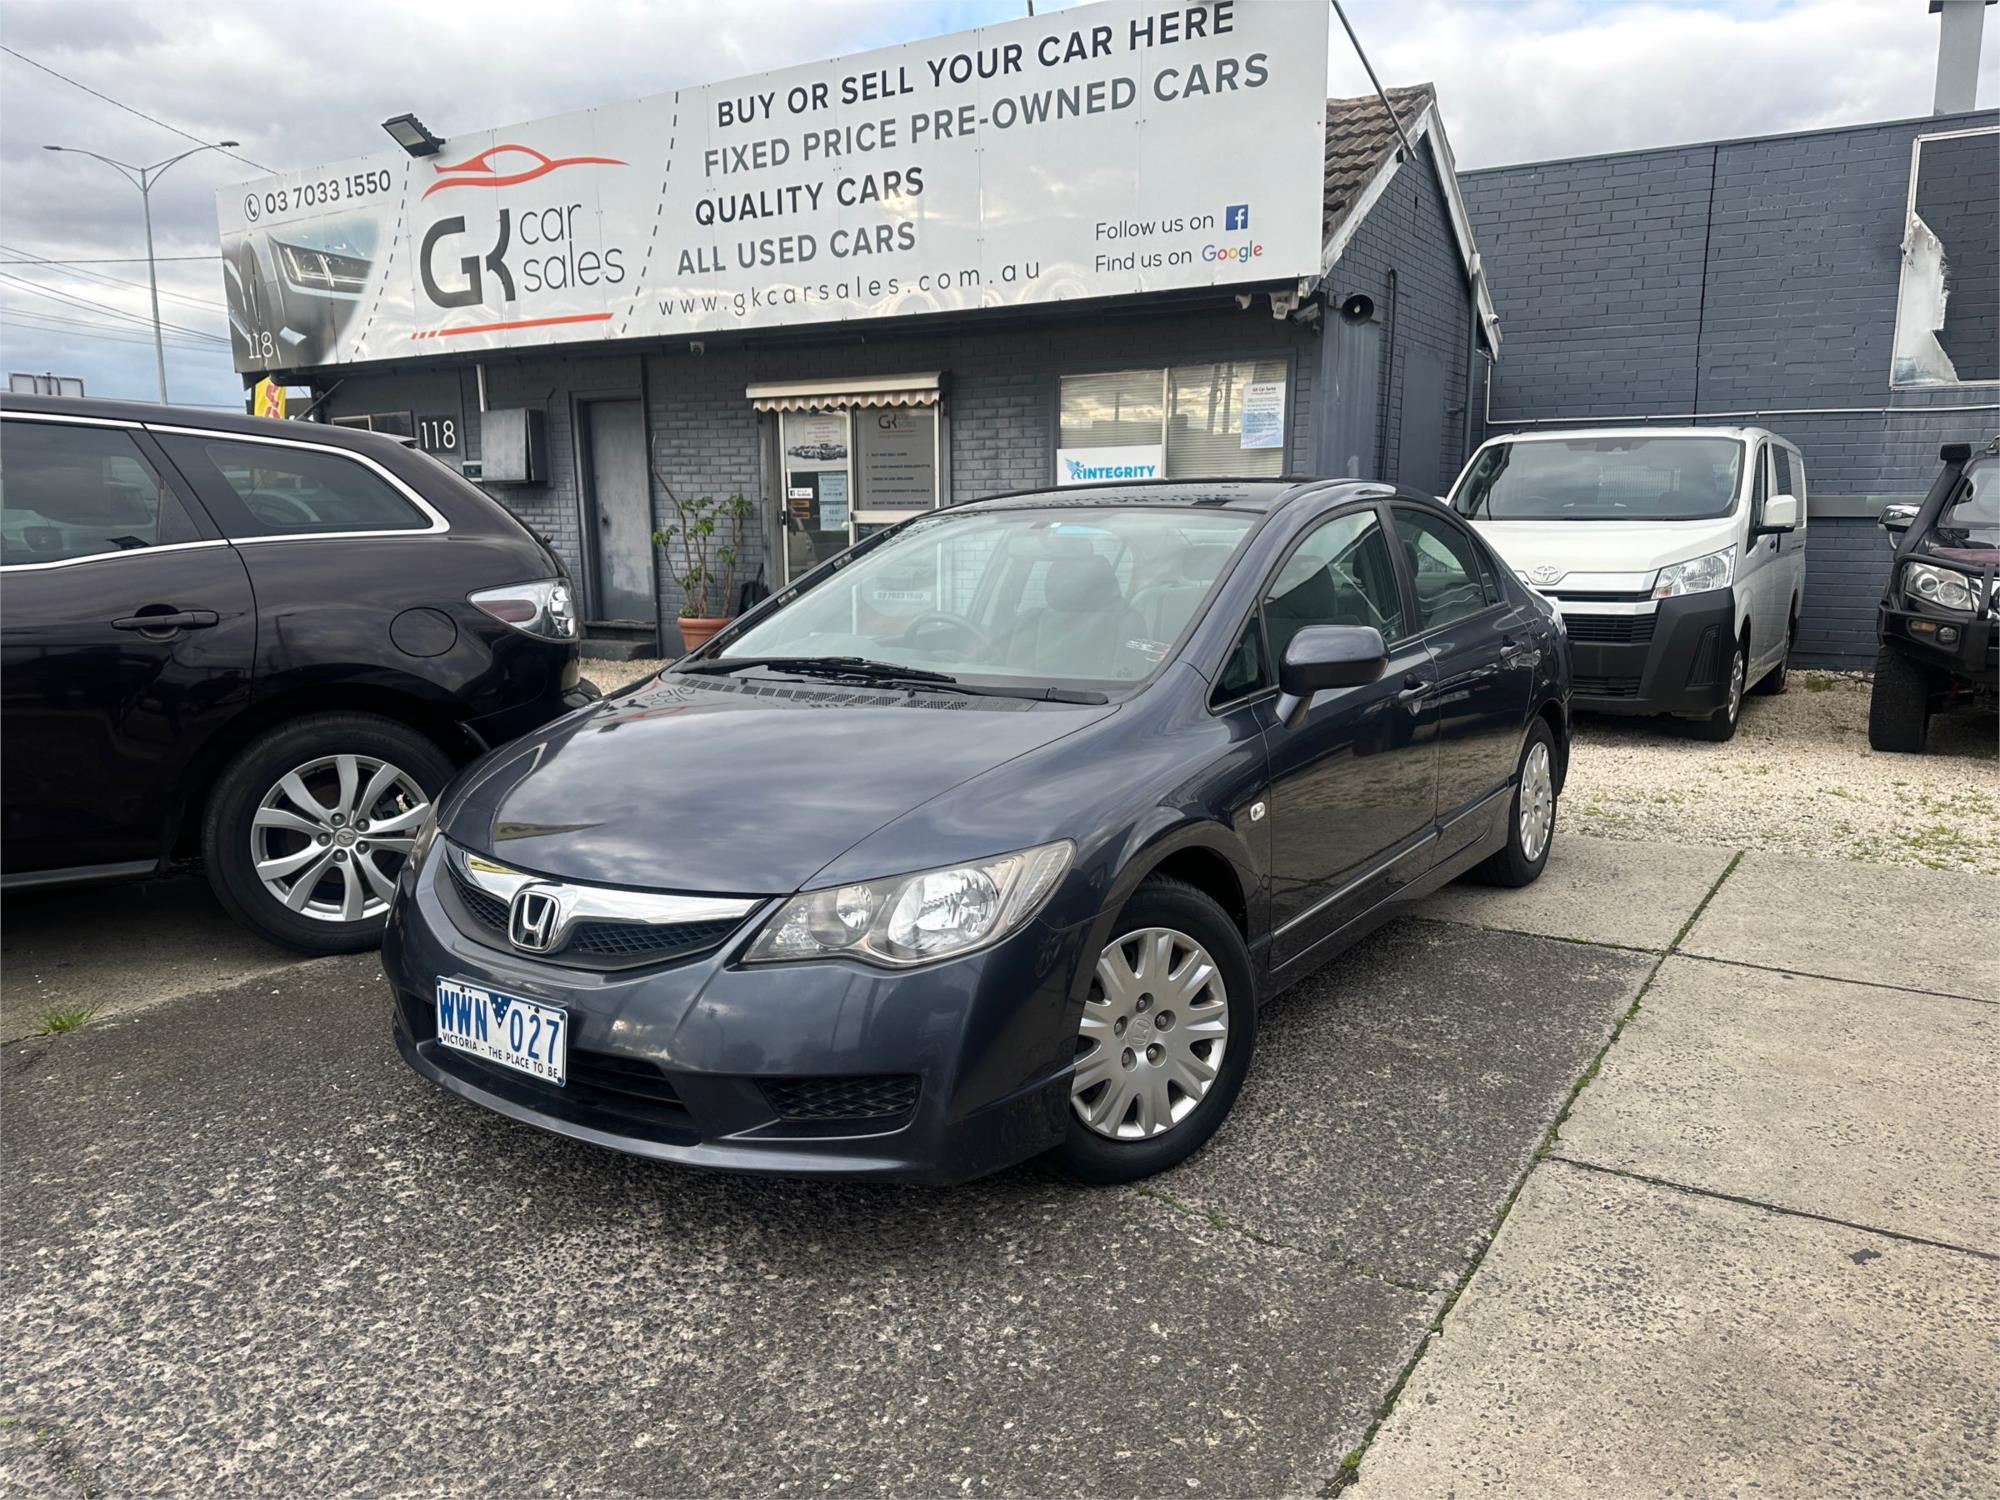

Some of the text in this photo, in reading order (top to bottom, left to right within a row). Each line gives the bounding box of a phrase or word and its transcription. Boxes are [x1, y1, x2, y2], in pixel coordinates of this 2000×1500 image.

[718, 1, 1234, 127] BUY OR SELL YOUR CAR HERE
[705, 53, 1269, 177] FIXED PRICE PRE-OWNED CARS
[265, 169, 391, 214] 03 7033 1550
[695, 166, 924, 226] QUALITY CARS
[520, 203, 582, 245] car
[677, 221, 915, 276] ALL USED CARS
[1096, 220, 1156, 241] Follow
[1162, 218, 1184, 233] us
[1190, 214, 1214, 230] on
[420, 208, 516, 308] GK
[523, 240, 625, 293] sales
[1096, 240, 1263, 273] Find us on Google
[659, 259, 1041, 317] www.gkcarsales.com.au
[247, 331, 274, 360] 118
[421, 420, 456, 449] 118
[1082, 465, 1156, 480] INTEGRITY
[438, 988, 560, 1064] WWN 027
[442, 1031, 478, 1052] VICTORIA
[488, 1046, 502, 1060] THE
[506, 1051, 530, 1069] PLACE
[532, 1061, 544, 1074] TO
[547, 1066, 558, 1079] BE
